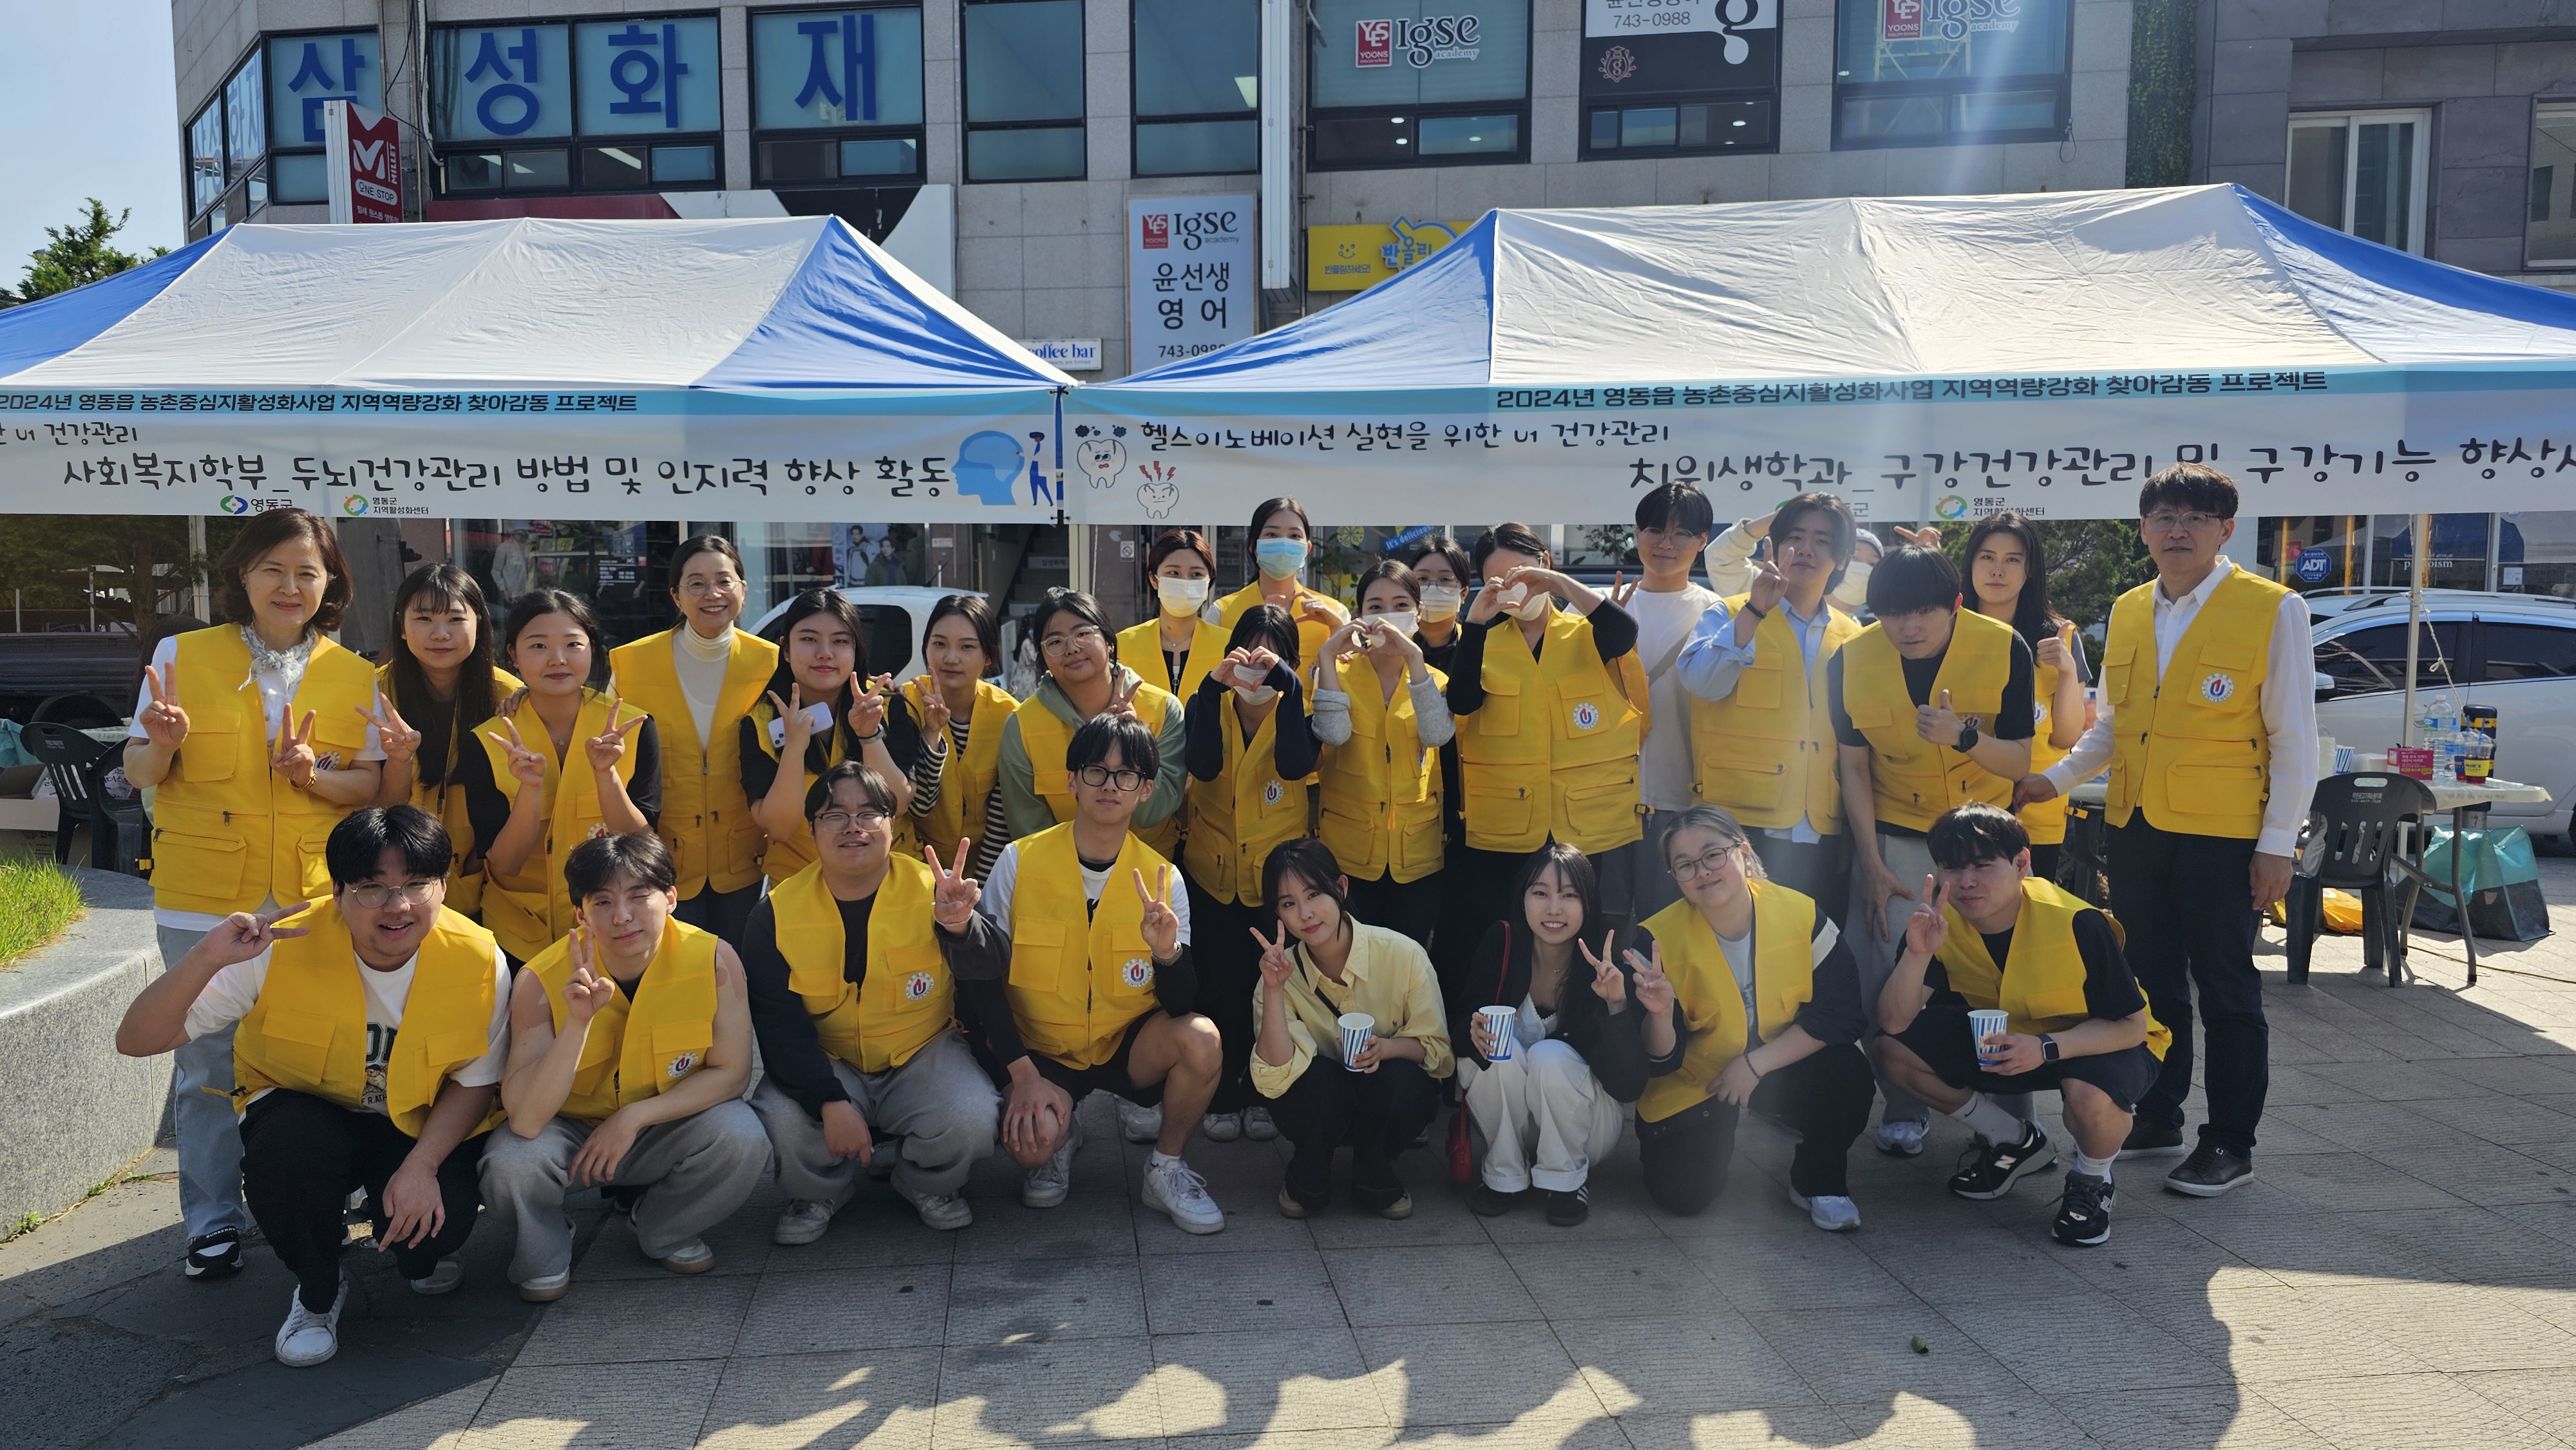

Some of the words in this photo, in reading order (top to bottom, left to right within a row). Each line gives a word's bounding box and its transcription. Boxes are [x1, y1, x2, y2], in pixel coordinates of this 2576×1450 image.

[1613, 11, 1691, 28] 743-0988
[1397, 16, 1481, 67] Igse
[1359, 50, 1388, 59] YOONS
[388, 142, 398, 185] MILLET
[359, 181, 374, 196] ONE
[377, 189, 395, 202] STOP
[1173, 211, 1238, 250] Igse
[1204, 236, 1240, 245] academy
[1152, 261, 1229, 292] 윤선생
[1072, 343, 1097, 359] bar
[1158, 344, 1226, 358] 743-098
[1497, 388, 1595, 409] 2024년
[1603, 386, 1676, 407] 영동읍
[1682, 379, 1933, 406] 농촌중심지활성화사업
[1942, 376, 2099, 400] 지역역량강화
[2105, 371, 2212, 397] 찾아감동
[2219, 370, 2328, 393] 프로젝트
[0, 393, 73, 411] 2024년
[79, 393, 135, 411] 영동읍
[140, 393, 336, 412] 농촌중심지활성화사업
[341, 393, 462, 412] 지역역량강화
[468, 394, 549, 412] 찾아감동
[554, 395, 638, 412] 프로젝트
[43, 422, 138, 446] 건강관리
[1141, 420, 1335, 451] 헬스이노베이션
[1346, 420, 1431, 451] 실현을
[1443, 422, 1502, 449] 위한
[1551, 420, 1668, 447] 건강관리
[2246, 439, 2437, 484] 구강기능
[516, 455, 590, 493] 방법
[605, 457, 642, 495] 및
[658, 458, 768, 496] 인지력
[784, 458, 861, 495] 향상
[874, 455, 951, 497] 활동
[372, 497, 397, 506] 영동군
[373, 506, 430, 515] 지역활성화센터
[1973, 497, 2006, 507] 영동군
[2300, 559, 2327, 571] ADT
